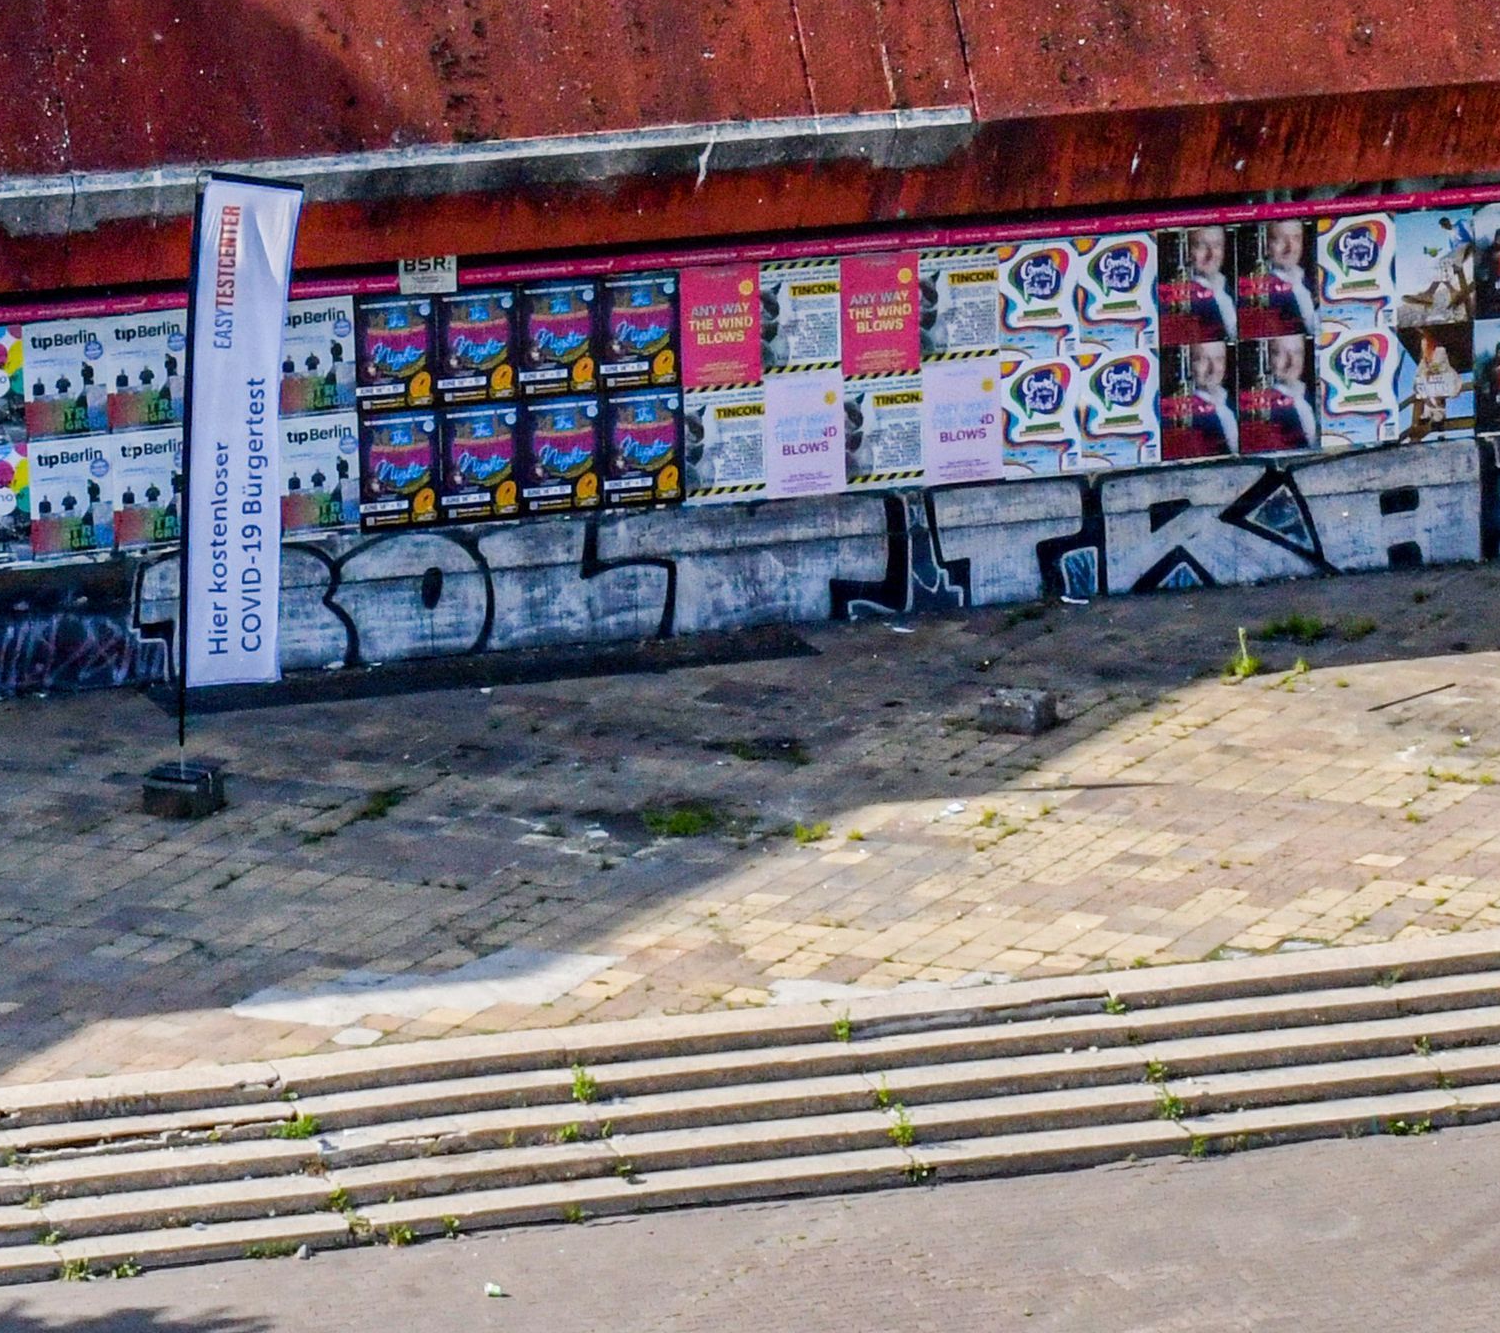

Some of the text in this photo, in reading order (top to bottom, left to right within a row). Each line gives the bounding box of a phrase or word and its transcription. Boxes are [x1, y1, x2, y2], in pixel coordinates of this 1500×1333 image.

[850, 289, 909, 306] ANY WAY
[691, 302, 750, 318] ANY WAY
[848, 304, 912, 320] THE WIND
[689, 316, 753, 332] THE WIND
[856, 319, 904, 333] BLOWS
[697, 331, 745, 345] BLOWS
[939, 428, 987, 443] BLOWS
[782, 441, 829, 456] BLOWS
[241, 377, 269, 653] COVID-19 Bürgertest
[208, 440, 230, 656] Hier kostenloser
